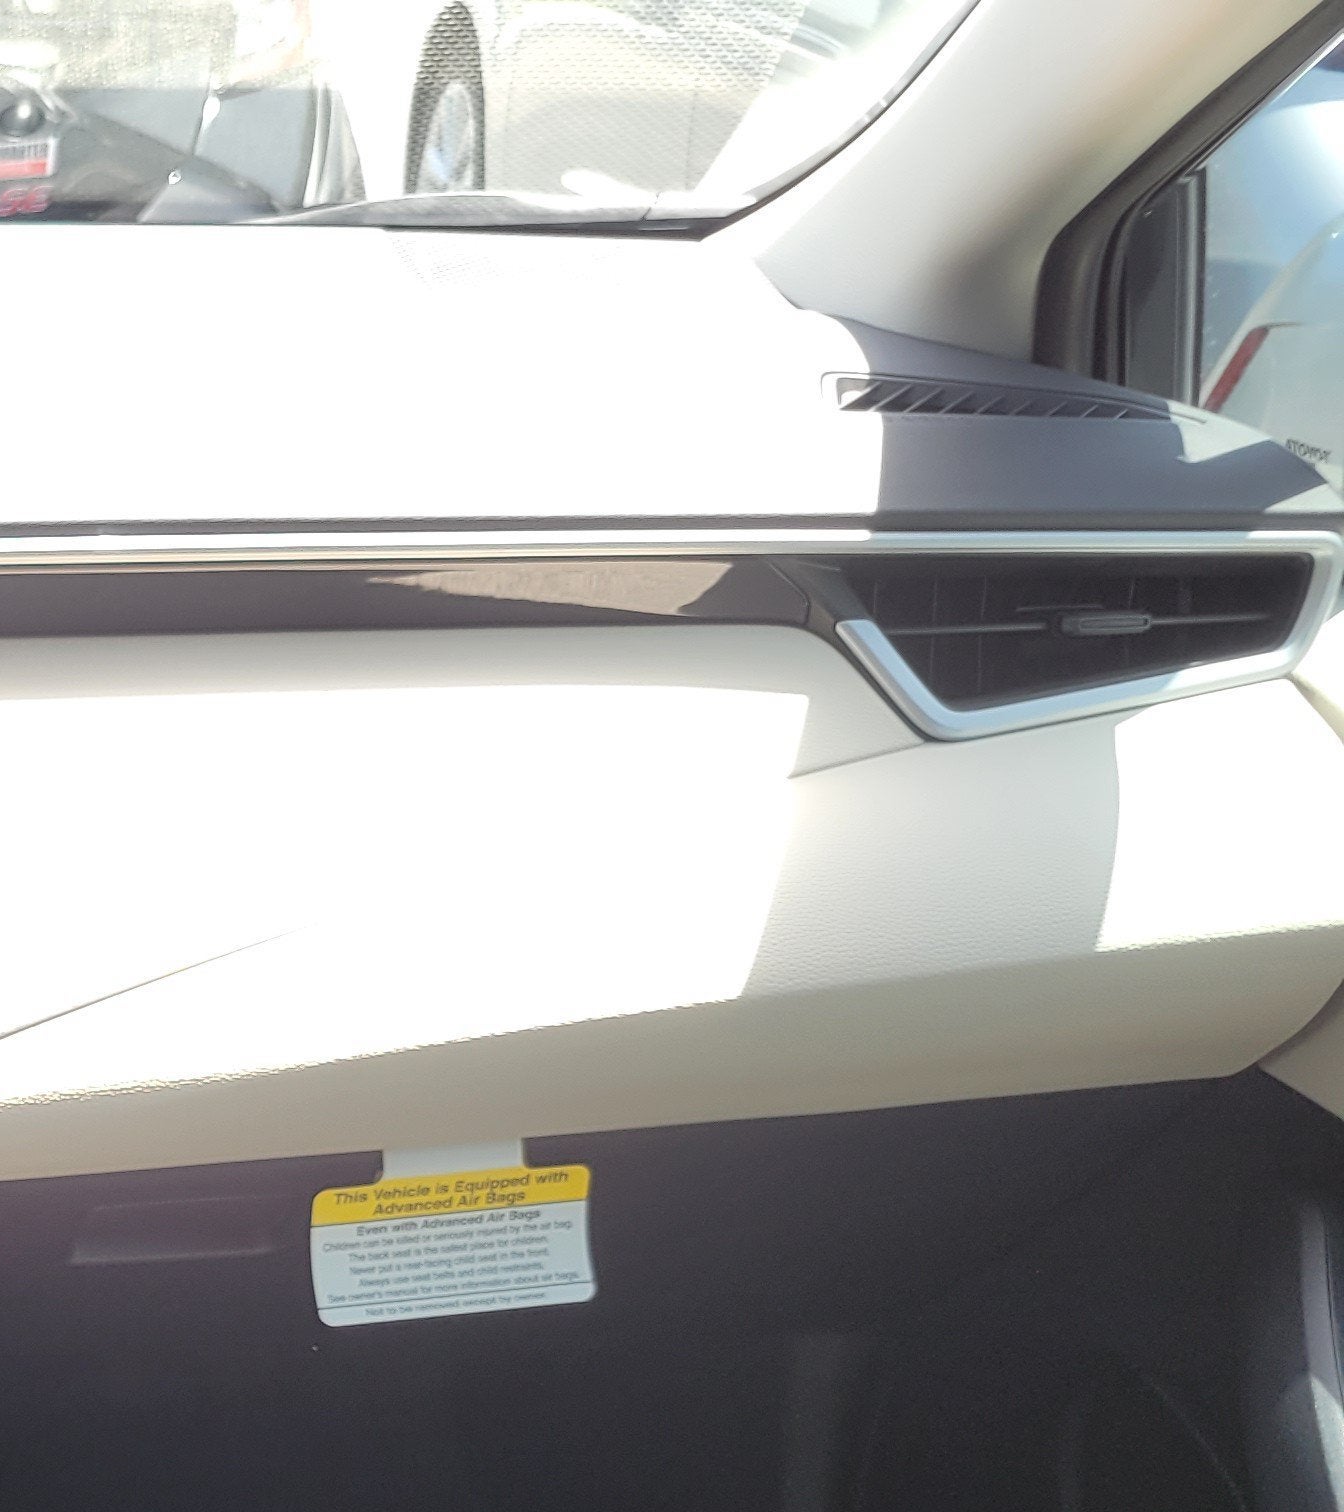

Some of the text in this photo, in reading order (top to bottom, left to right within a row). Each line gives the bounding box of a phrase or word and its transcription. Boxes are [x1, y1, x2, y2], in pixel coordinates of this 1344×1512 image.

[335, 1170, 569, 1205] This Vehicle is Equipped with
[373, 1191, 526, 1215] Advanced Air Bags
[356, 1209, 541, 1237] Even with Advanced Air Bags
